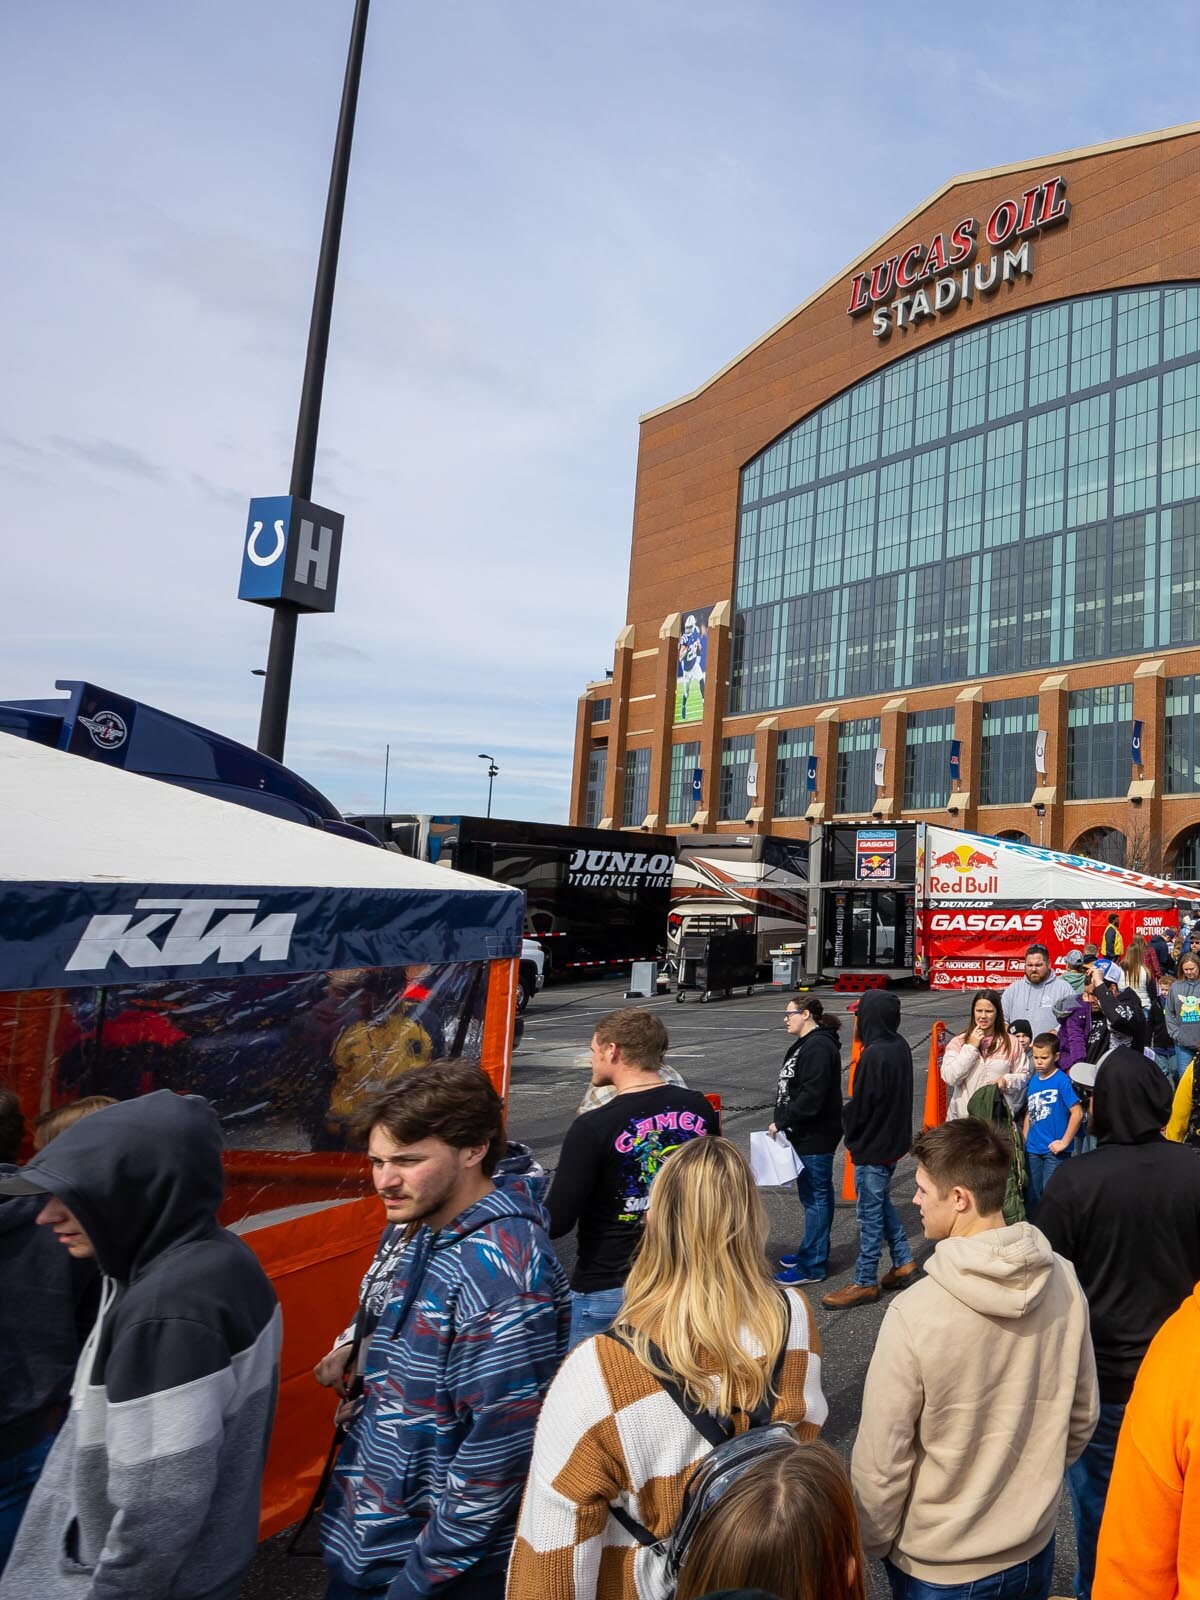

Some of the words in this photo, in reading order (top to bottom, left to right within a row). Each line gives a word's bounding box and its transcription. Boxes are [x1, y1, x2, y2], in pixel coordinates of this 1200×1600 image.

[847, 217, 977, 316] LUCAS
[986, 176, 1070, 246] OIL
[872, 241, 1032, 338] STADIUM
[294, 518, 333, 590] H
[929, 875, 962, 893] Red
[966, 875, 998, 893] Bull
[1095, 901, 1136, 910] seaspan
[930, 914, 1043, 931] GASGAS
[1143, 916, 1163, 926] SONY
[64, 898, 297, 971] KTM
[928, 934, 984, 942] FACTORY
[946, 961, 981, 969] MOTOREX
[615, 1112, 707, 1154] CAMEL
